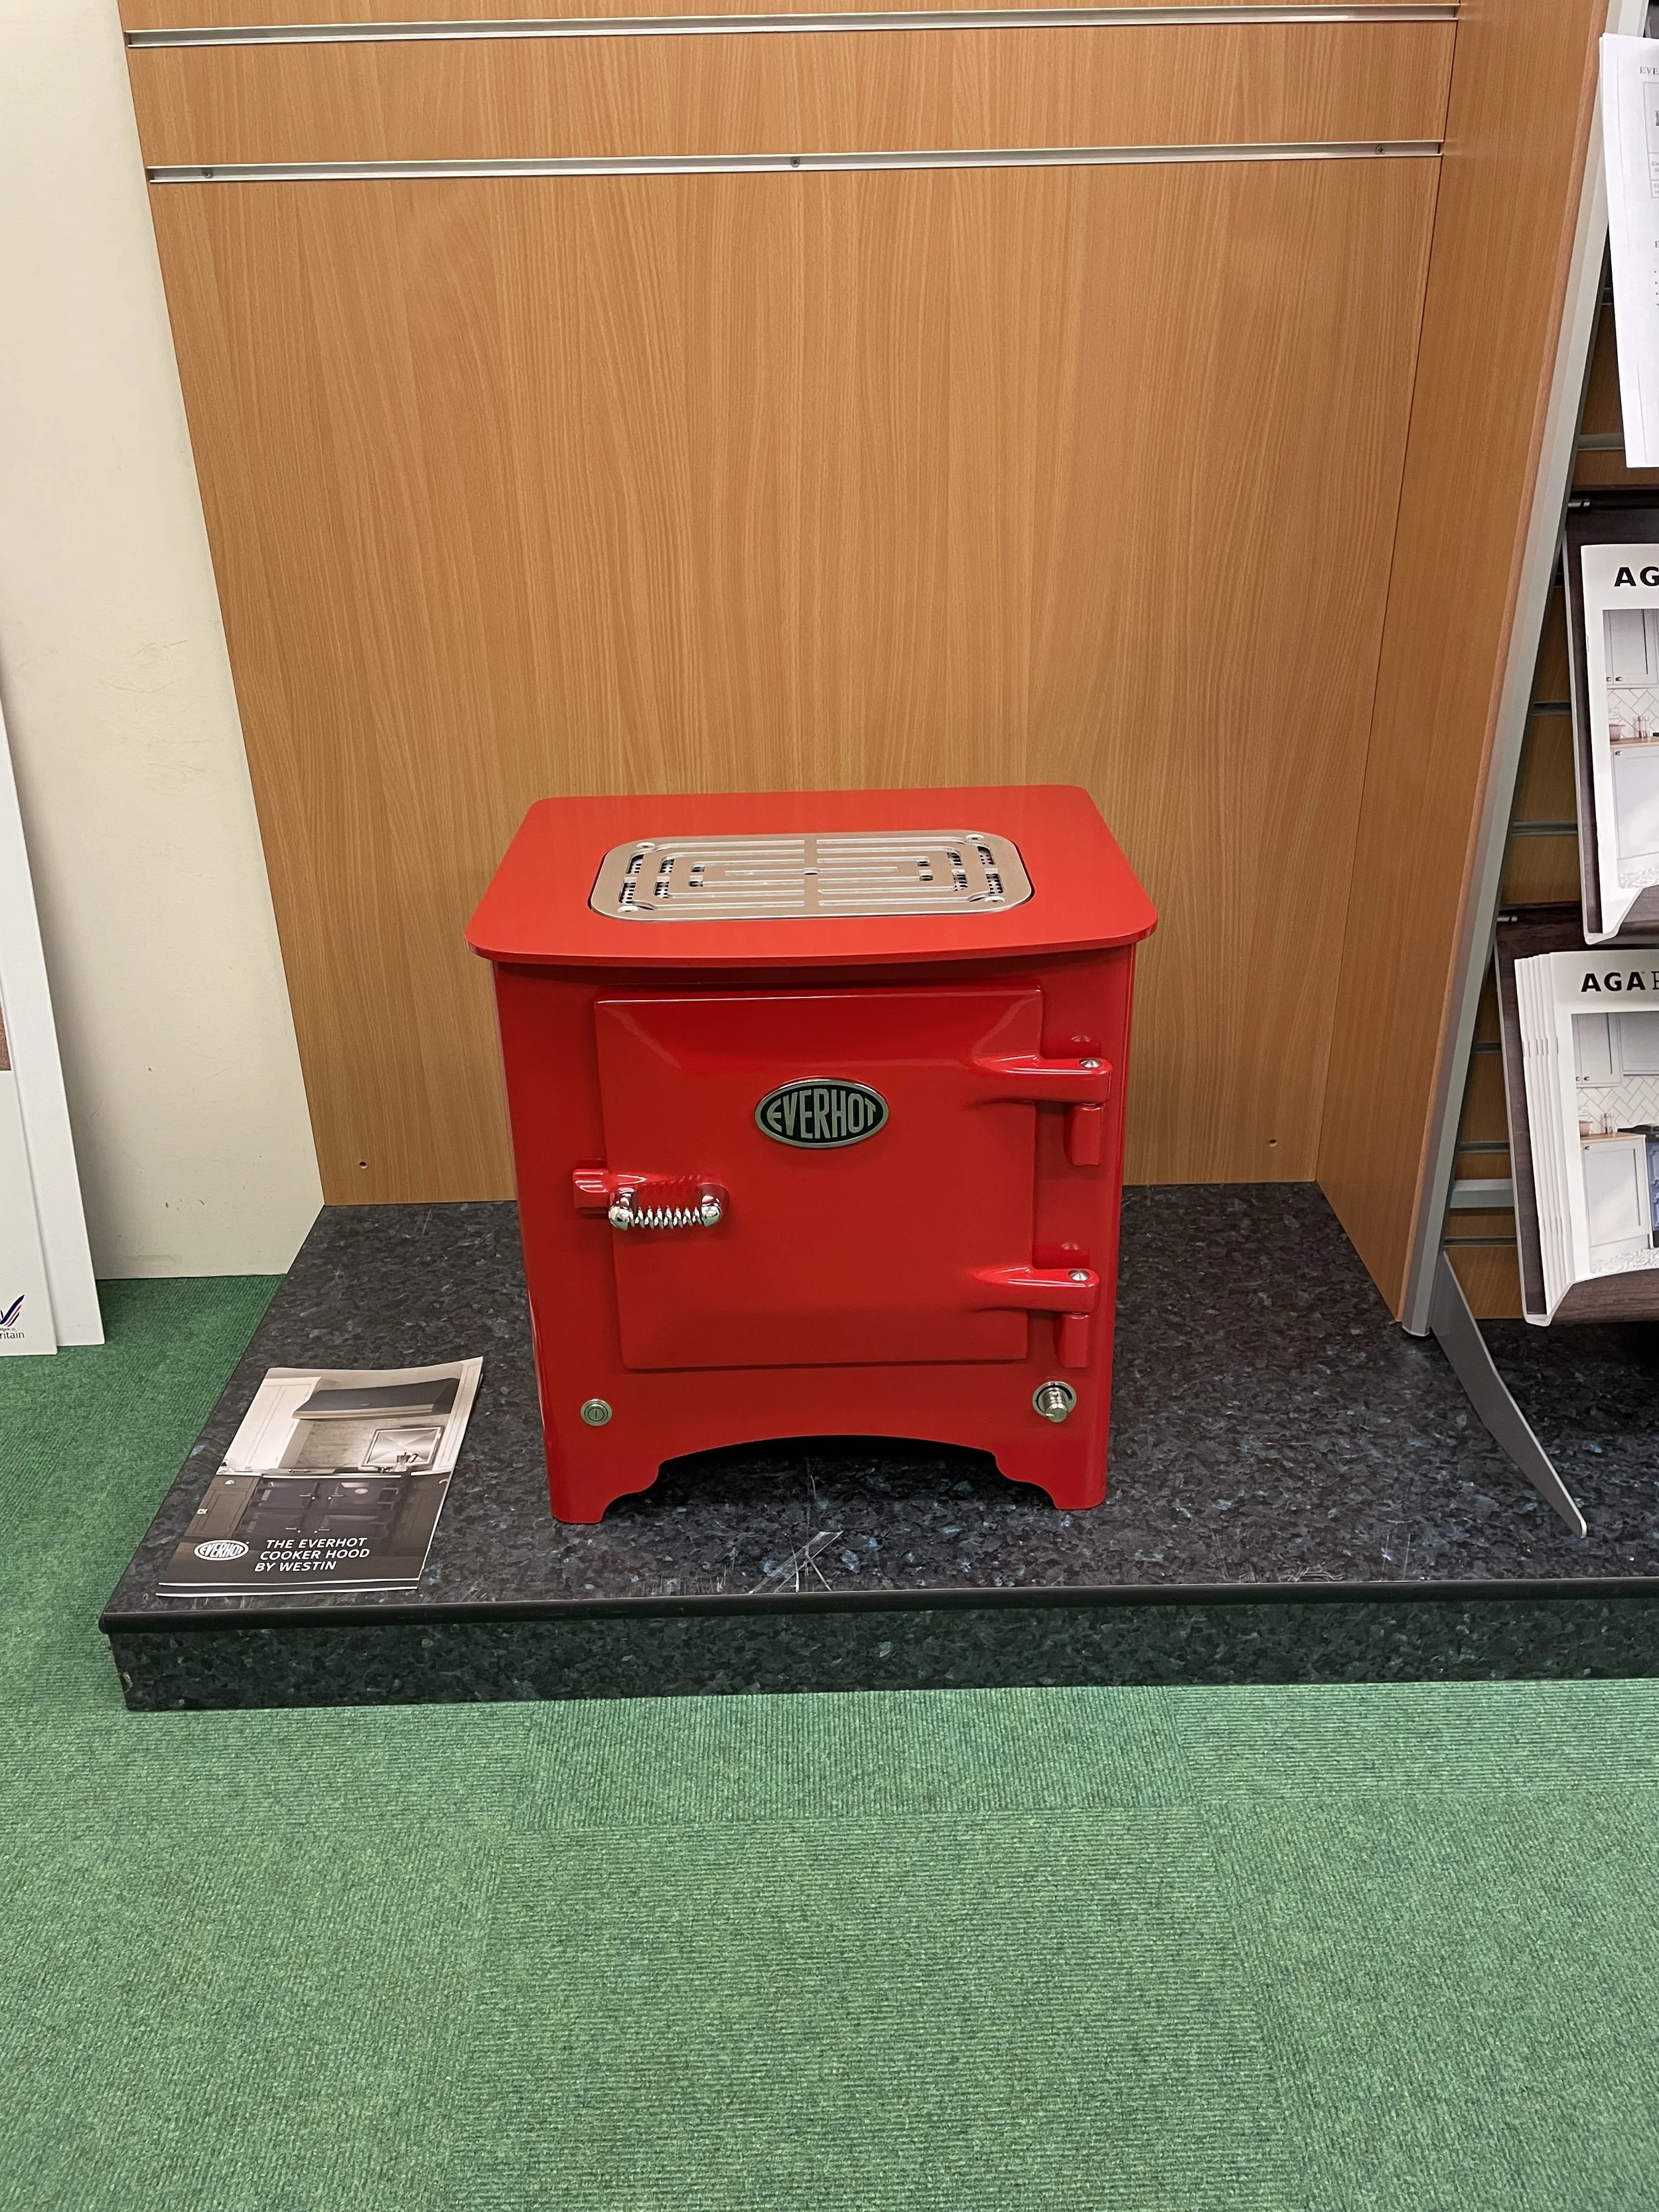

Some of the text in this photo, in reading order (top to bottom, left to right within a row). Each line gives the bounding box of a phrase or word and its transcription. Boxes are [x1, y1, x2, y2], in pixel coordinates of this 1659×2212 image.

[1581, 971, 1646, 993] AGA
[766, 1088, 877, 1140] EVERHOT
[198, 1542, 244, 1558] EVERHOT
[266, 1537, 368, 1549] THE EVERHOT
[259, 1548, 370, 1560] COOKER HOOD
[254, 1560, 337, 1572] BY WESTIN
